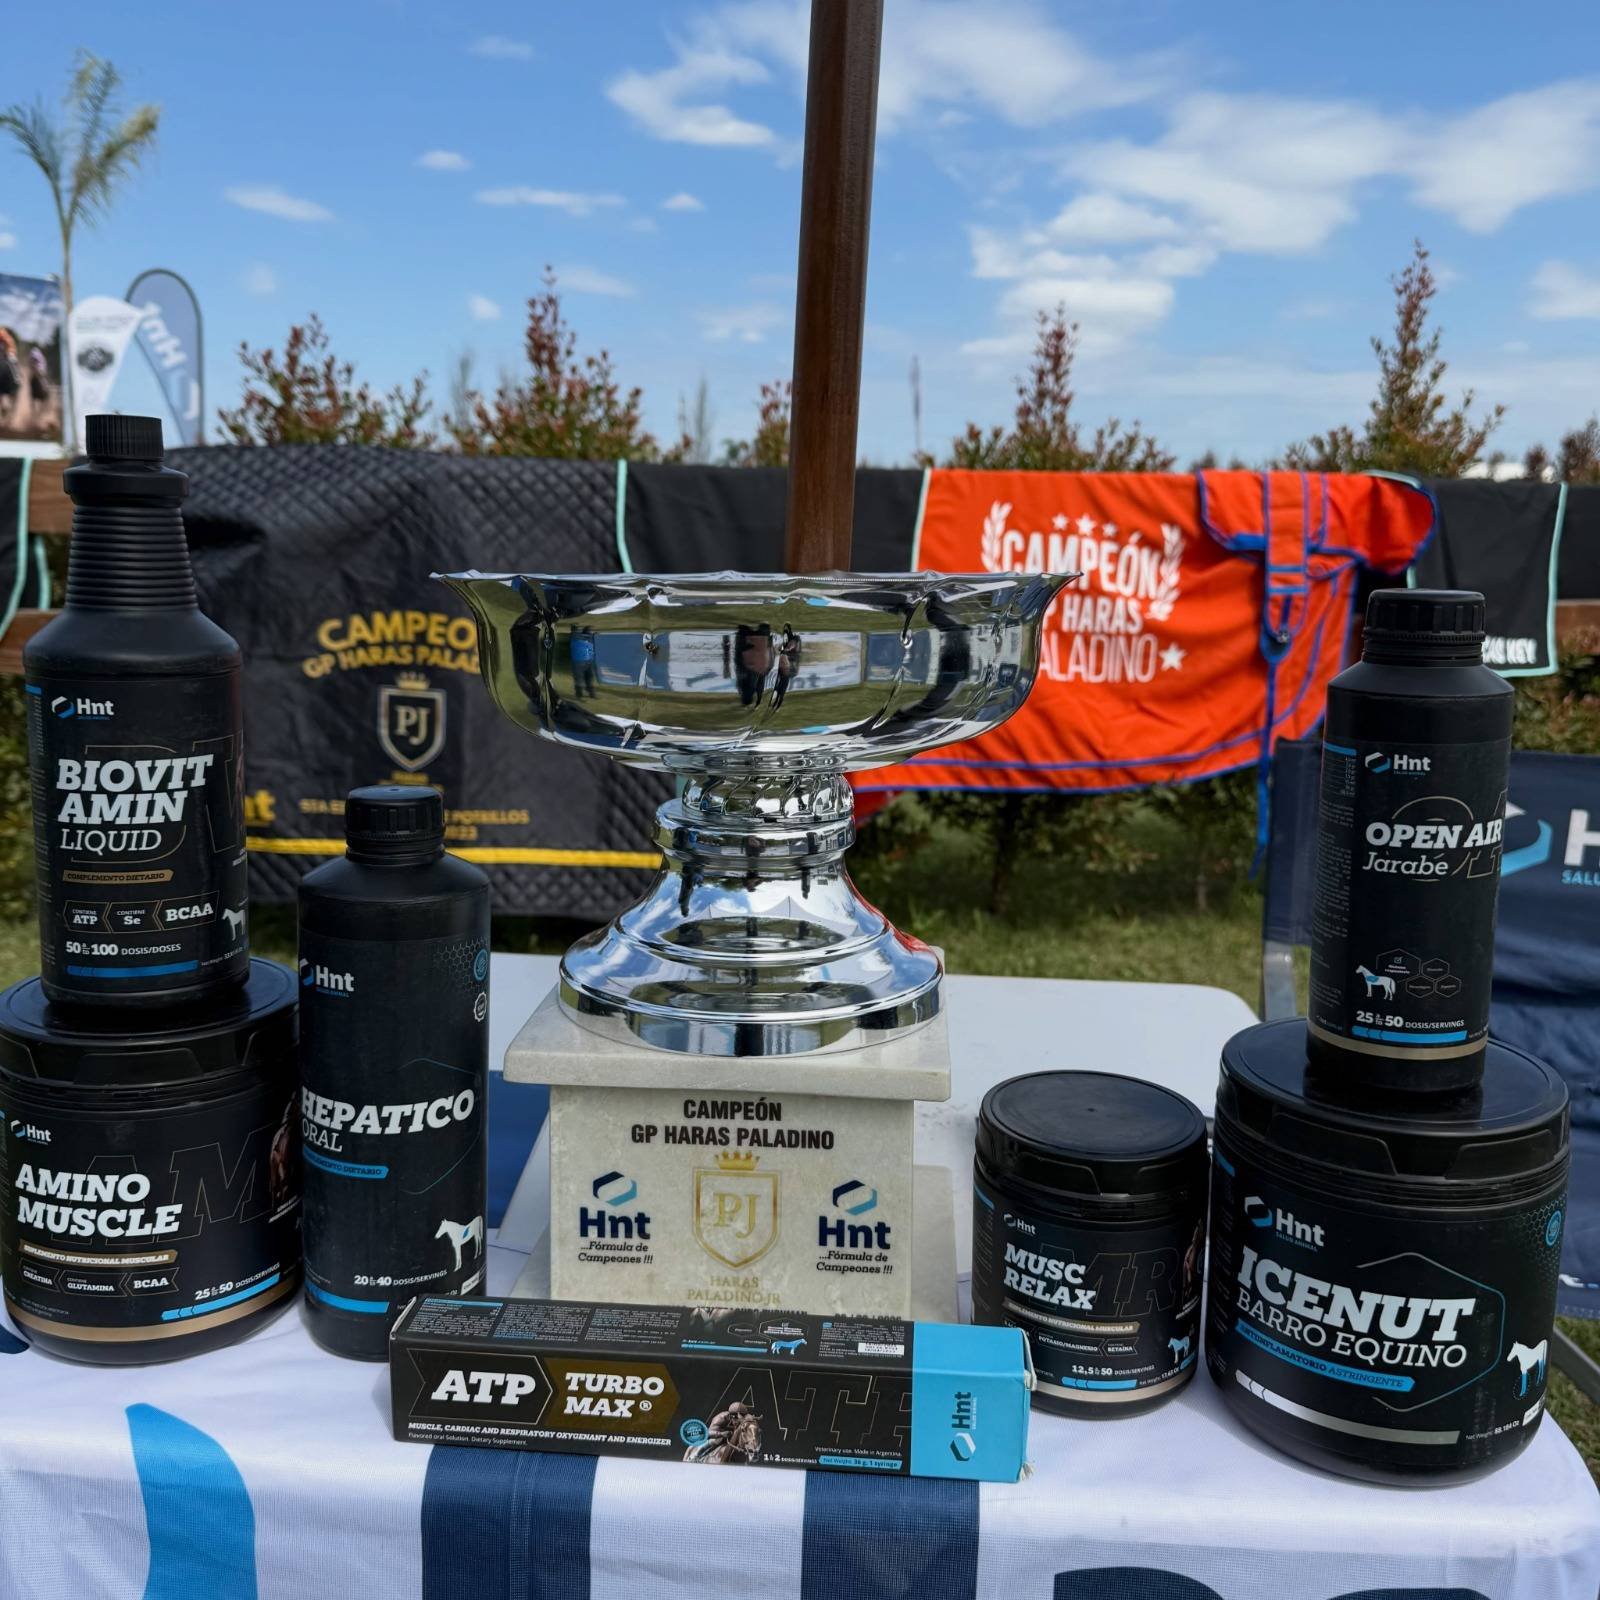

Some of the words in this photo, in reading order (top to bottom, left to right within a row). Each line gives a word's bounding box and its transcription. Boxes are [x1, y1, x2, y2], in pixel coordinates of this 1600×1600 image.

[1002, 529, 1163, 599] CAMPEÓN
[1062, 593, 1145, 635] HARAS
[317, 611, 478, 650] CAMPEO
[1039, 631, 1159, 684] ALADINO
[76, 697, 115, 716] Hnt
[394, 704, 430, 746] PJ
[56, 754, 214, 792] BIOVIT
[1393, 753, 1431, 772] Hnt
[57, 791, 188, 825] AMIN
[59, 828, 162, 856] LIQUID
[1365, 823, 1462, 849] OPEN
[1466, 818, 1503, 848] AIR
[1363, 852, 1448, 875] Jarabe
[67, 872, 124, 882] COMPLEMENTO
[125, 872, 165, 881] DIETARIO
[72, 914, 99, 926] ATP
[123, 915, 142, 926] Se
[165, 902, 214, 923] BCAA
[65, 941, 82, 955] 50
[91, 943, 119, 957] 100
[120, 943, 182, 957] DOSIS/DOSES
[315, 964, 355, 992] Hnt
[1355, 1011, 1374, 1024] 25
[1384, 1015, 1404, 1028] 50
[1405, 1019, 1465, 1030] DOSIS/SERVINGS
[301, 1086, 475, 1135] HEPATICO
[683, 1097, 782, 1121] CAMPEÓN
[26, 1123, 52, 1142] Hnt
[302, 1118, 343, 1153] ORAL
[631, 1124, 658, 1144] GP
[664, 1126, 731, 1146] HARAS
[737, 1127, 835, 1150] PALADINO
[15, 1163, 150, 1203] AMINO
[17, 1196, 183, 1238] MUSCLE
[580, 1206, 651, 1240] Hnt
[712, 1191, 761, 1240] PJ
[1017, 1218, 1036, 1235] Hnt
[1276, 1207, 1326, 1247] Hnt
[818, 1215, 891, 1250] Hnt
[578, 1252, 642, 1265] Campeones
[635, 1242, 649, 1252] de
[874, 1252, 889, 1262] de
[816, 1261, 881, 1275] Campeones
[1004, 1242, 1086, 1284] MUSC
[67, 1282, 115, 1292] GLUTAMINA
[133, 1277, 170, 1290] BCAA
[354, 1274, 369, 1286] 20
[376, 1275, 393, 1287] 40
[394, 1270, 448, 1286] DOSIS/SERVINGS
[709, 1275, 760, 1288] HARAS
[1003, 1266, 1096, 1311] RELAX
[195, 1288, 211, 1301] 25
[219, 1281, 234, 1293] 50
[687, 1288, 762, 1303] PALADINO
[1237, 1245, 1476, 1342] ICENUT
[1236, 1286, 1327, 1347] BARRO
[1331, 1331, 1467, 1368] EQUINO
[1072, 1364, 1094, 1376] 12,5
[1101, 1367, 1113, 1376] 50
[1328, 1365, 1404, 1388] ASTRINGENTE
[431, 1370, 536, 1405] ATP
[565, 1372, 665, 1396] TURBO
[951, 1391, 972, 1430] Hnt
[408, 1422, 443, 1432] MUSCLE,
[444, 1425, 480, 1434] CARDIAC
[481, 1427, 499, 1435] AND
[500, 1428, 554, 1439] RESPIRATORY
[556, 1431, 607, 1441] OXYGENANT
[607, 1434, 625, 1442] AND
[626, 1436, 672, 1446] ENERGIZER
[471, 1436, 492, 1445] Dietary
[763, 1453, 769, 1462] 1
[774, 1454, 781, 1462] 2
[875, 1460, 898, 1469] syringe
